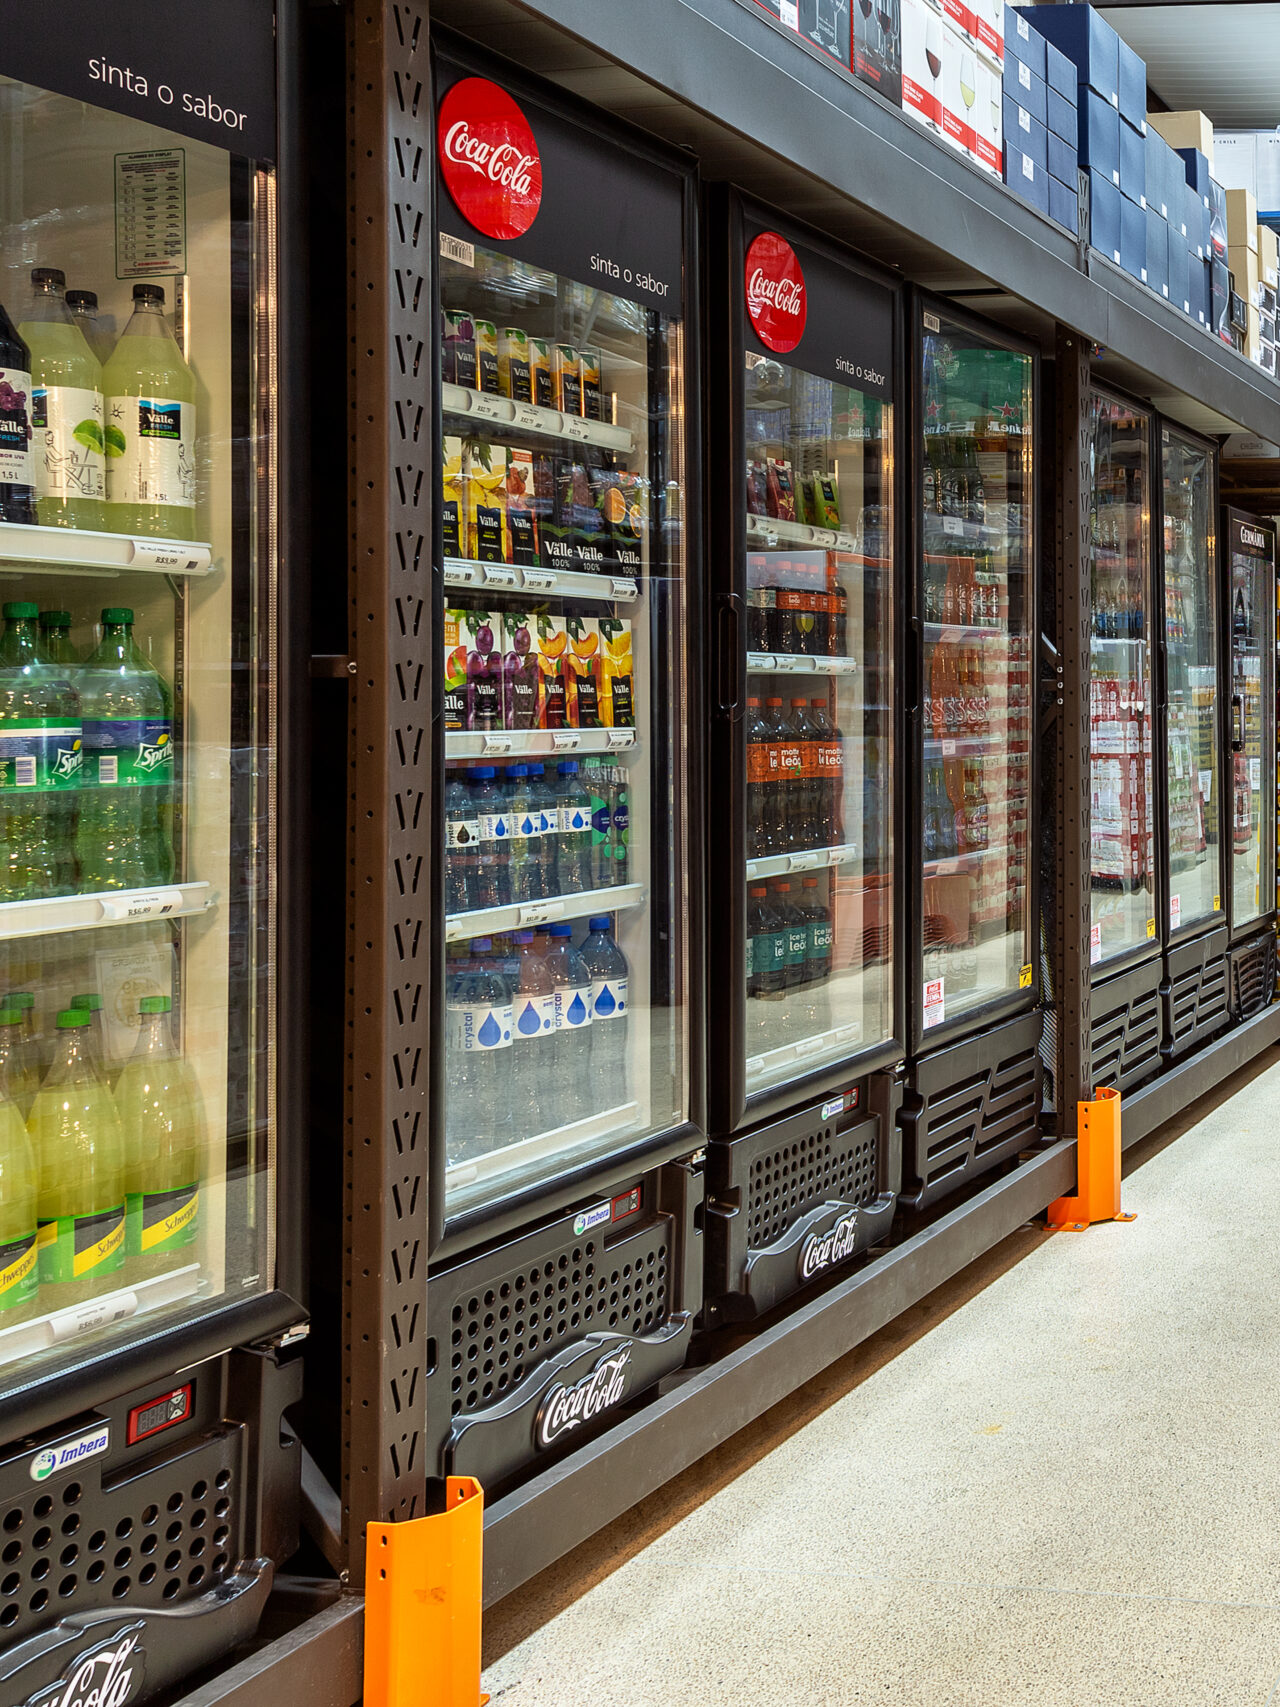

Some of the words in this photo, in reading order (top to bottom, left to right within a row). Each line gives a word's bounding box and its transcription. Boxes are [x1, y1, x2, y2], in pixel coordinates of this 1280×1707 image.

[89, 56, 149, 97] sinta
[157, 85, 174, 105] o
[182, 95, 248, 131] sabor
[444, 120, 536, 196] Coca-Cola
[590, 253, 620, 279] sinta
[623, 268, 633, 283] o
[635, 272, 669, 297] sabor
[748, 267, 804, 317] Coca-Cola
[835, 355, 855, 375] sinta
[856, 366, 862, 378] o
[864, 368, 886, 387] sabor
[552, 559, 570, 568] 100%
[583, 562, 600, 572] 100%
[554, 993, 562, 1027] crystal
[464, 1012, 474, 1050] crystal
[586, 1206, 610, 1227] Imbera
[803, 1214, 858, 1278] Coca-Cola
[542, 1350, 632, 1444] Coca-Cola
[58, 1434, 107, 1465] Imbera
